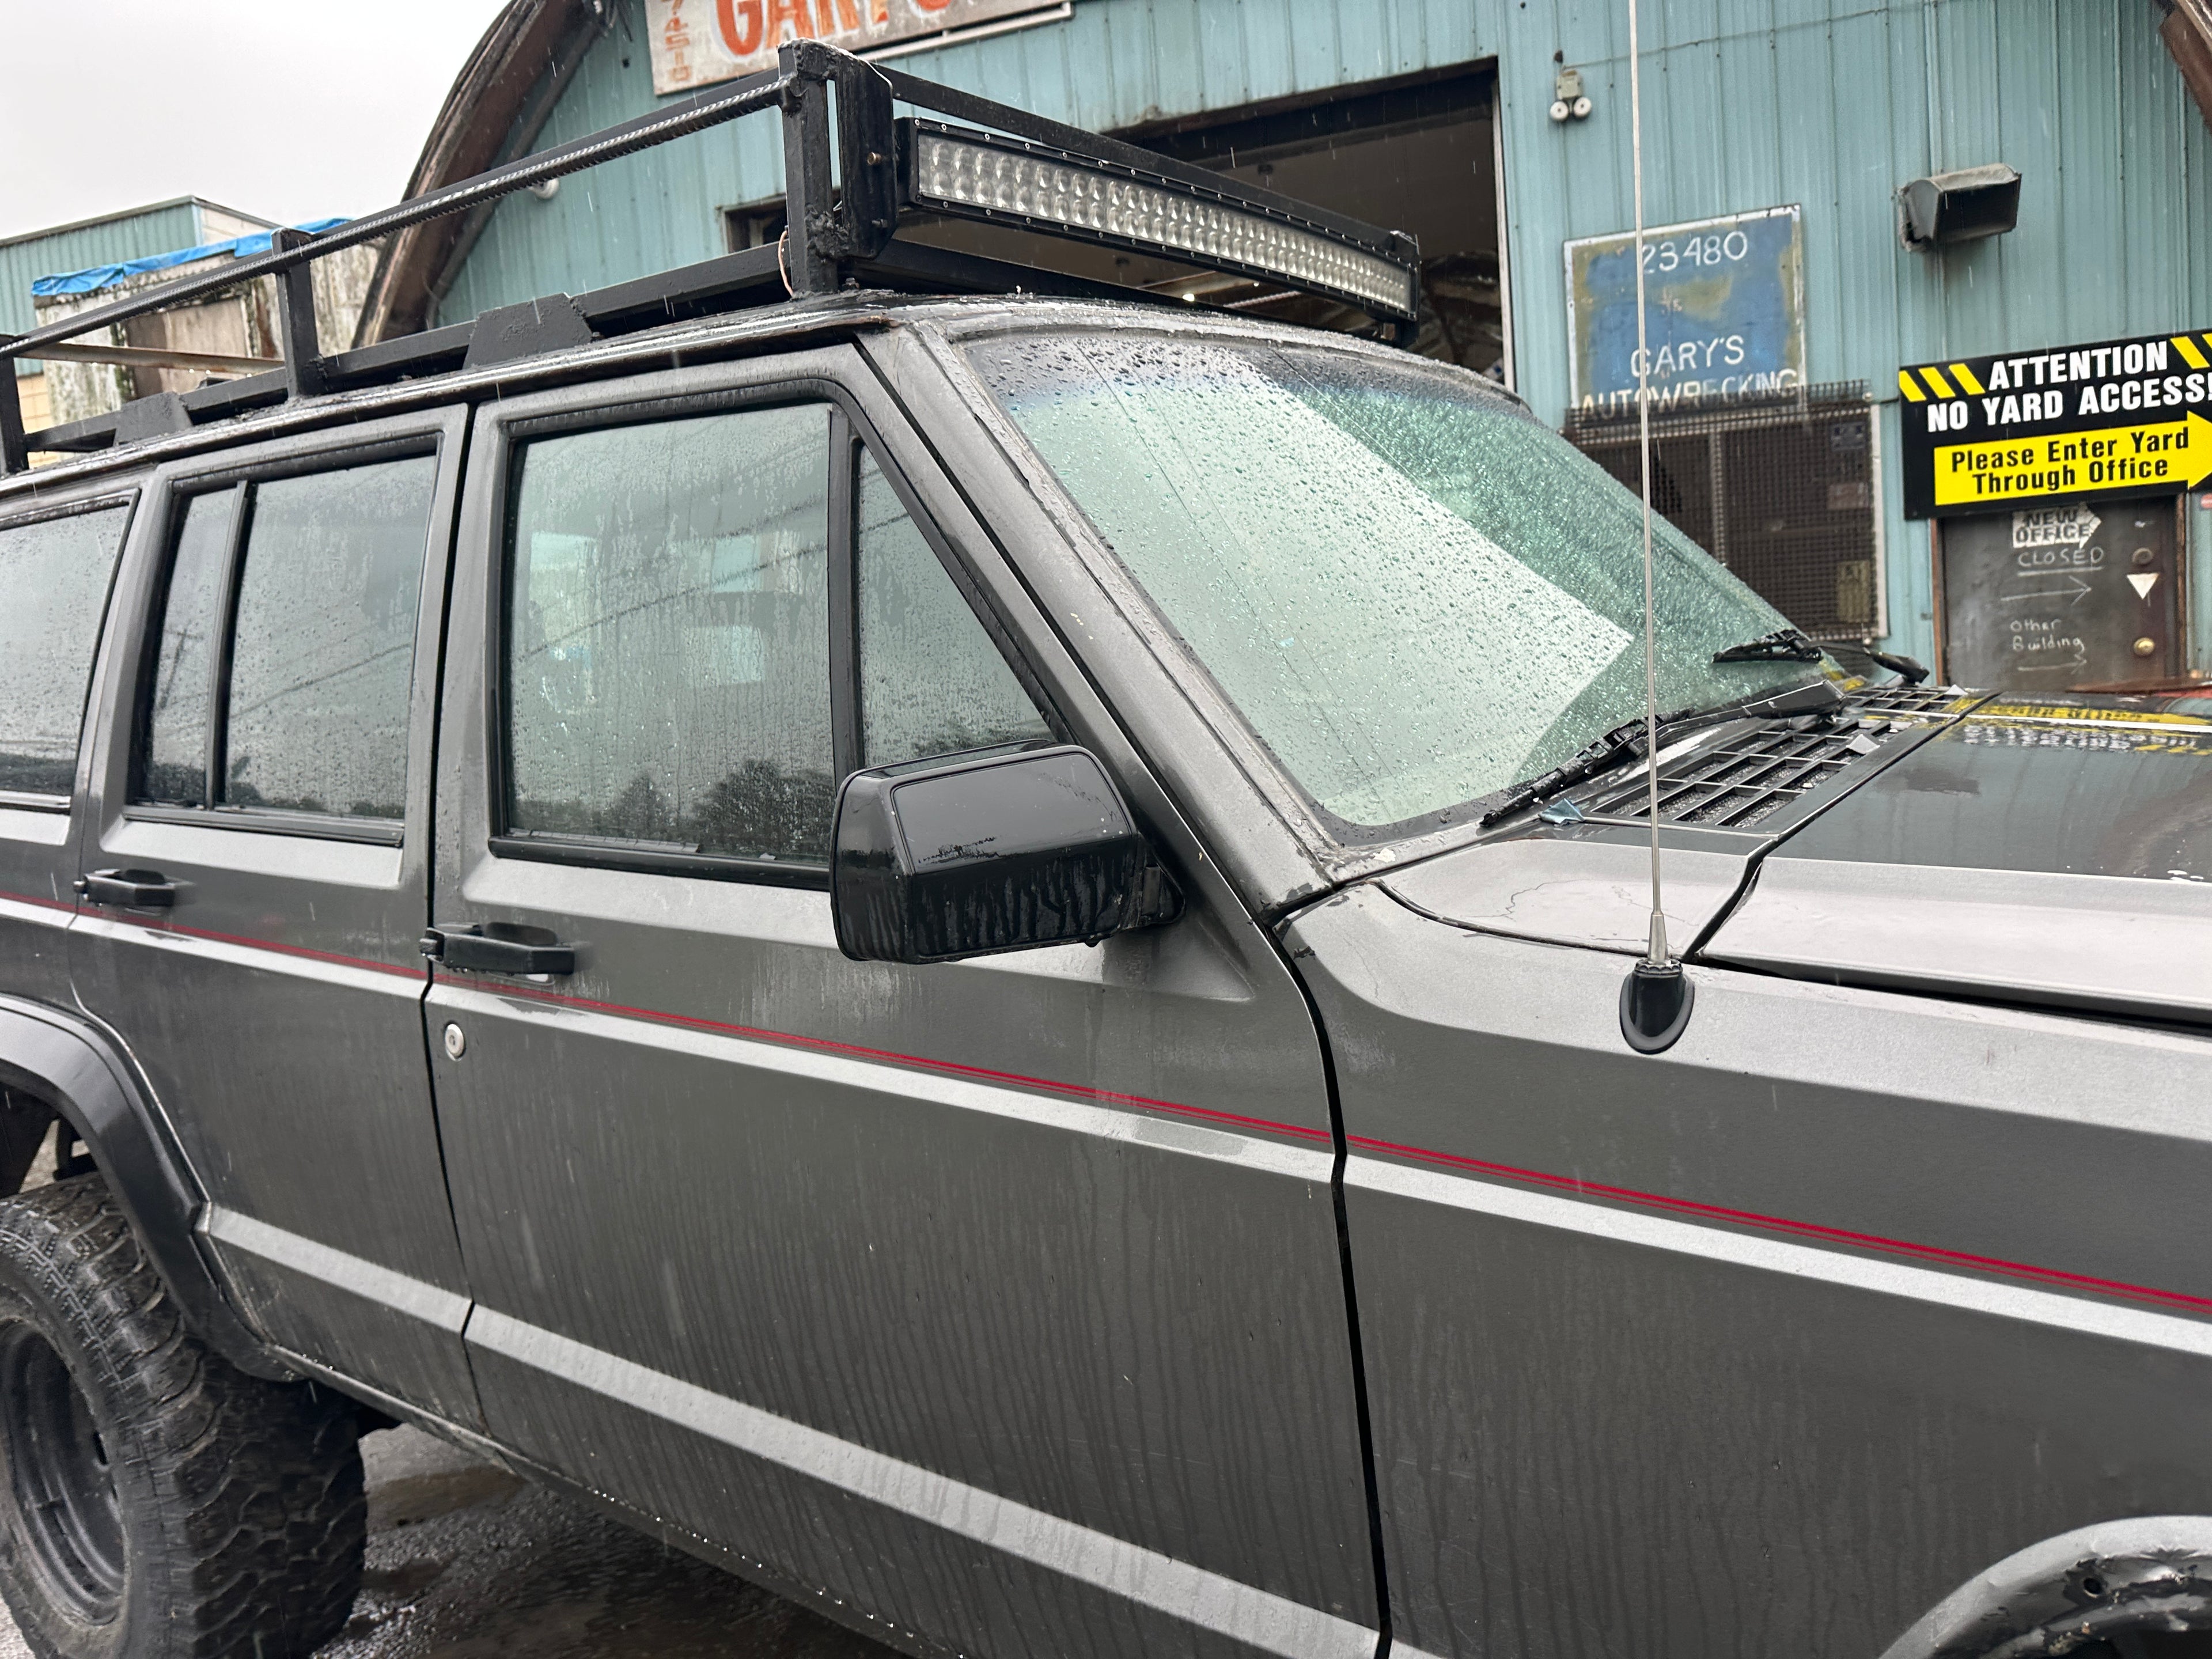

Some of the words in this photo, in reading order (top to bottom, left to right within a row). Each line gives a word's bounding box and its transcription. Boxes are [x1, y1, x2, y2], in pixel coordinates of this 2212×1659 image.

[1642, 230, 1748, 274] 23480
[1630, 335, 1745, 378] GARY'S
[1988, 341, 2168, 391] ATTENTION
[1927, 400, 1968, 433] NO
[1982, 390, 2063, 426] YARD
[1951, 445, 2034, 472] Please
[2048, 437, 2118, 461] Enter
[2130, 426, 2190, 453] Yard
[1972, 465, 2075, 494] Through
[2089, 457, 2168, 483] Office
[2016, 523, 2090, 542] OFFICE
[2024, 507, 2077, 527] NEW
[2018, 546, 2103, 567] CLOSED
[2010, 618, 2062, 632] Other
[2013, 634, 2085, 655] Building
